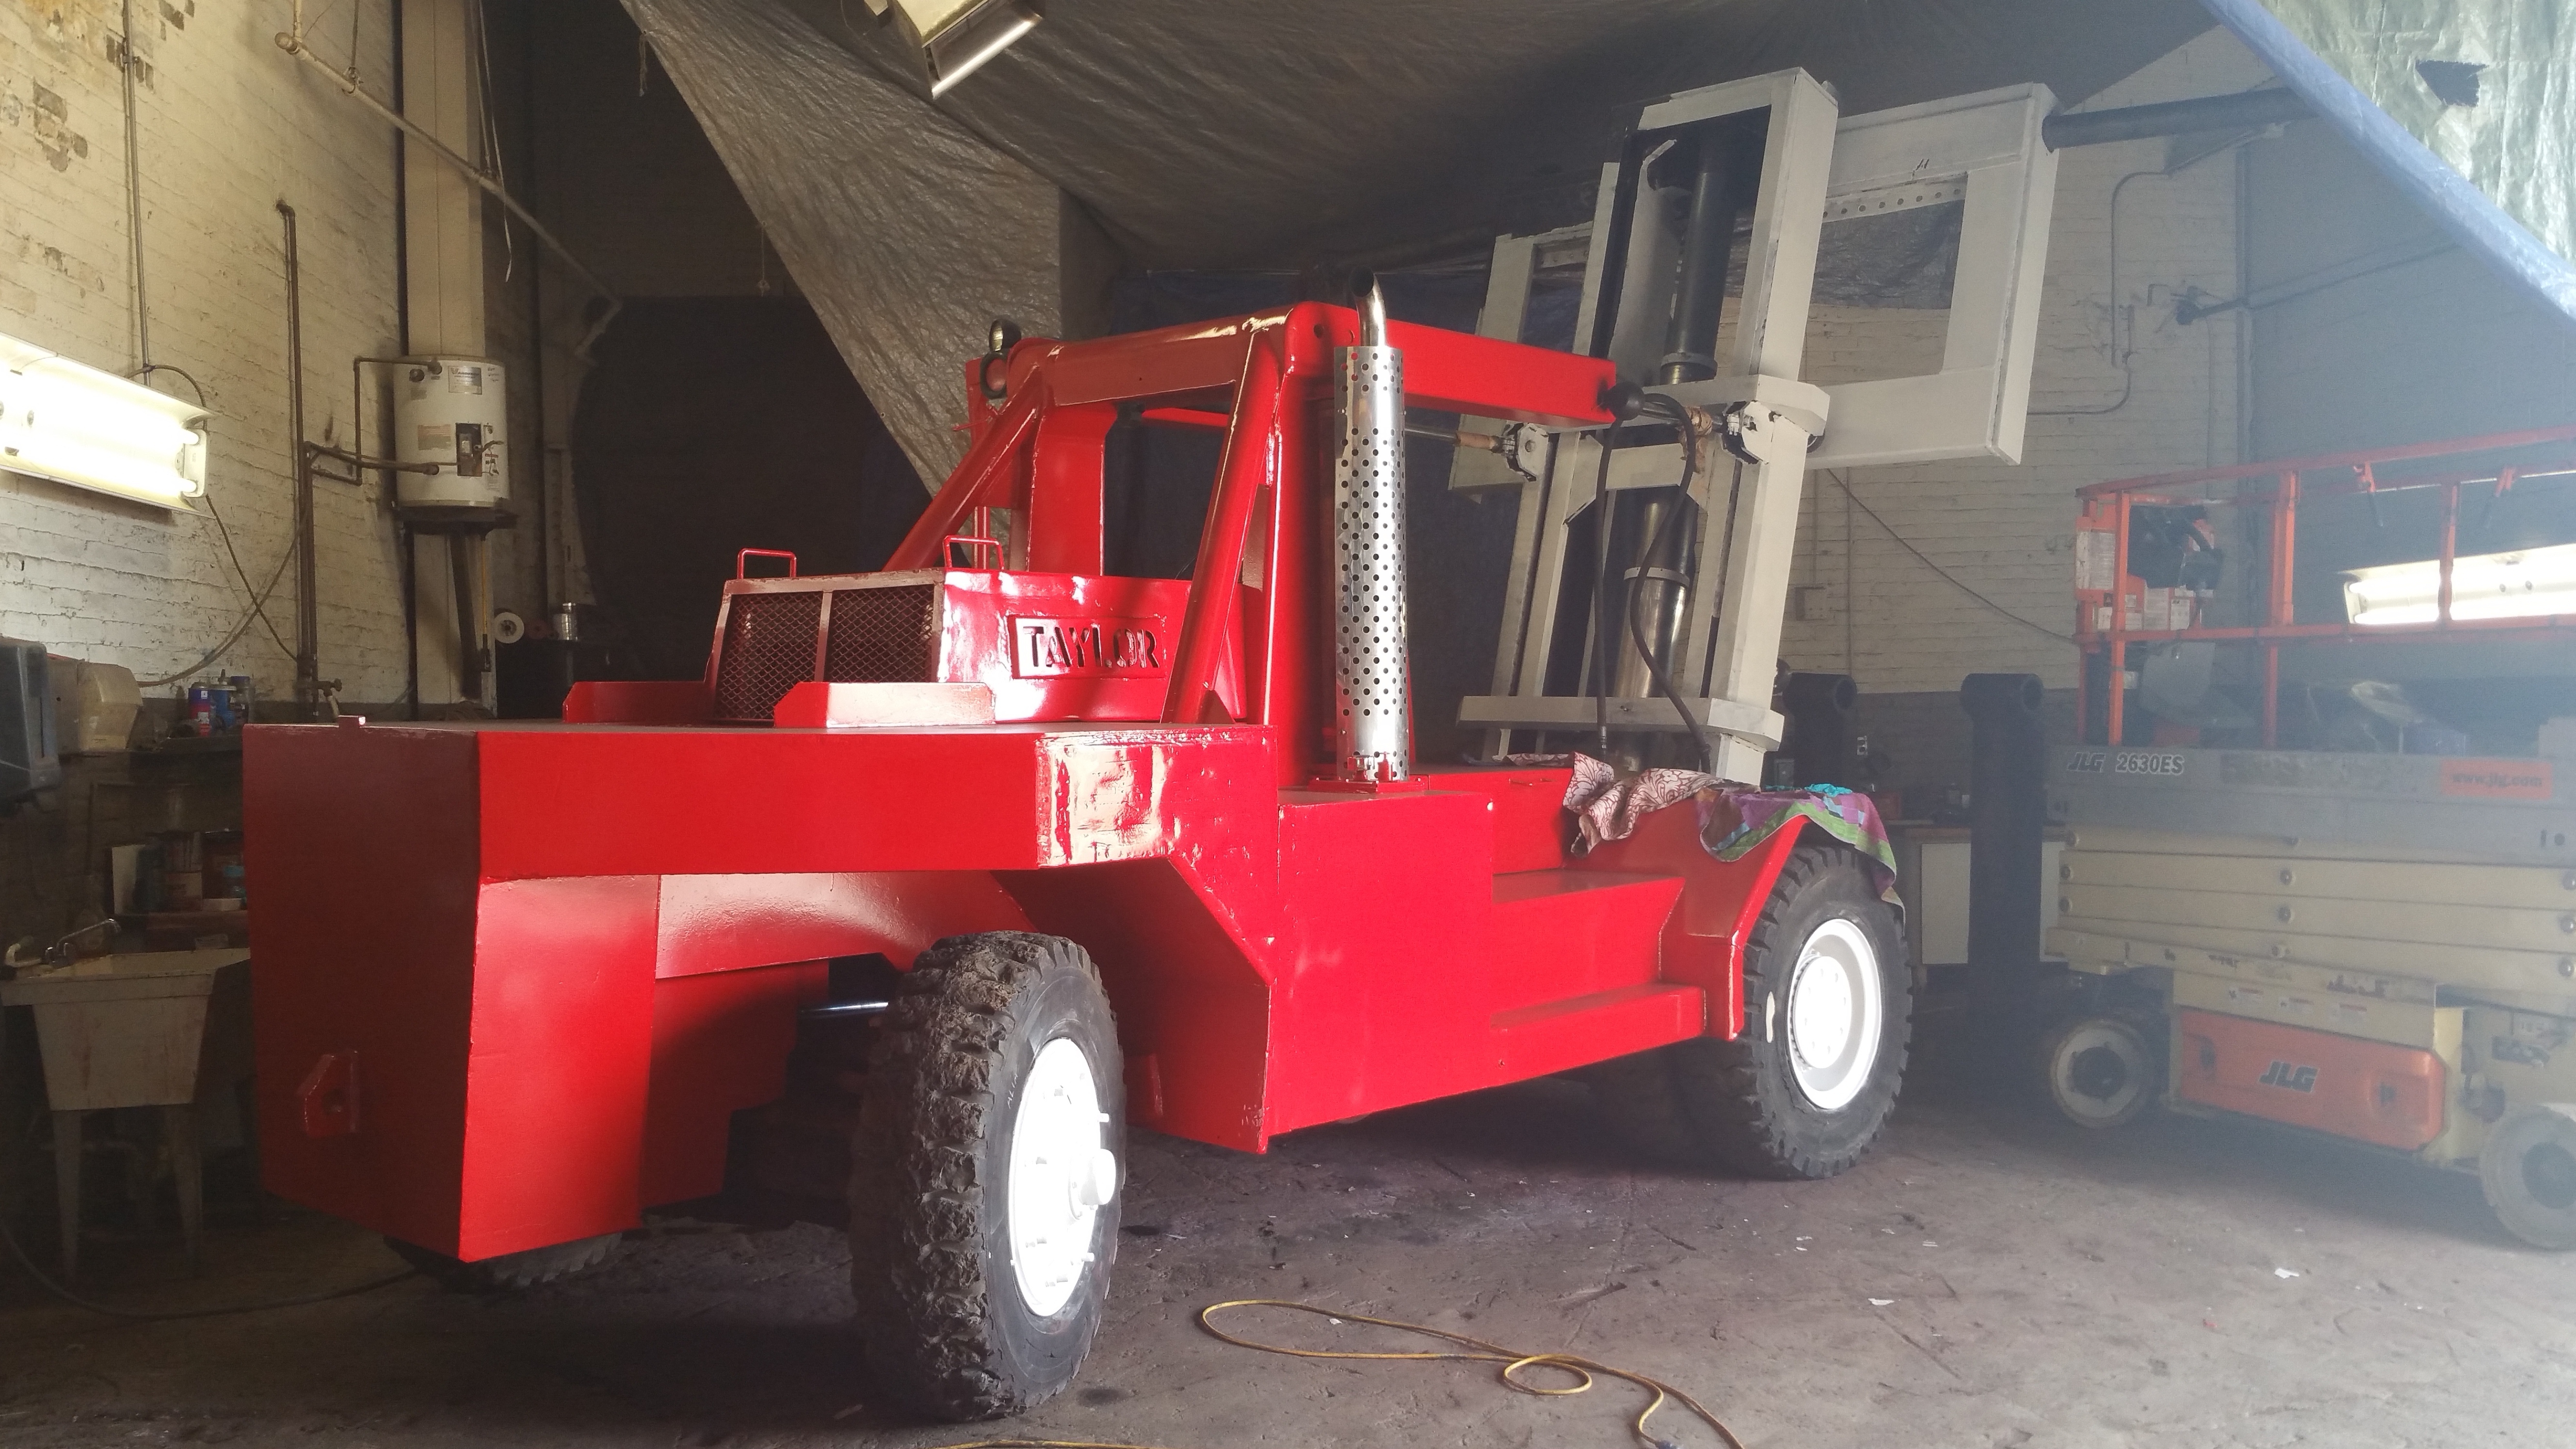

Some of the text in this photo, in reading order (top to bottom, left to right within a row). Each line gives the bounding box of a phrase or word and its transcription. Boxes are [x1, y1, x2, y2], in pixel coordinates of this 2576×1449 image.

[1022, 624, 1160, 668] TAYLOR
[2067, 752, 2185, 775] JLG 2630ES
[2258, 1060, 2320, 1094] JLG
